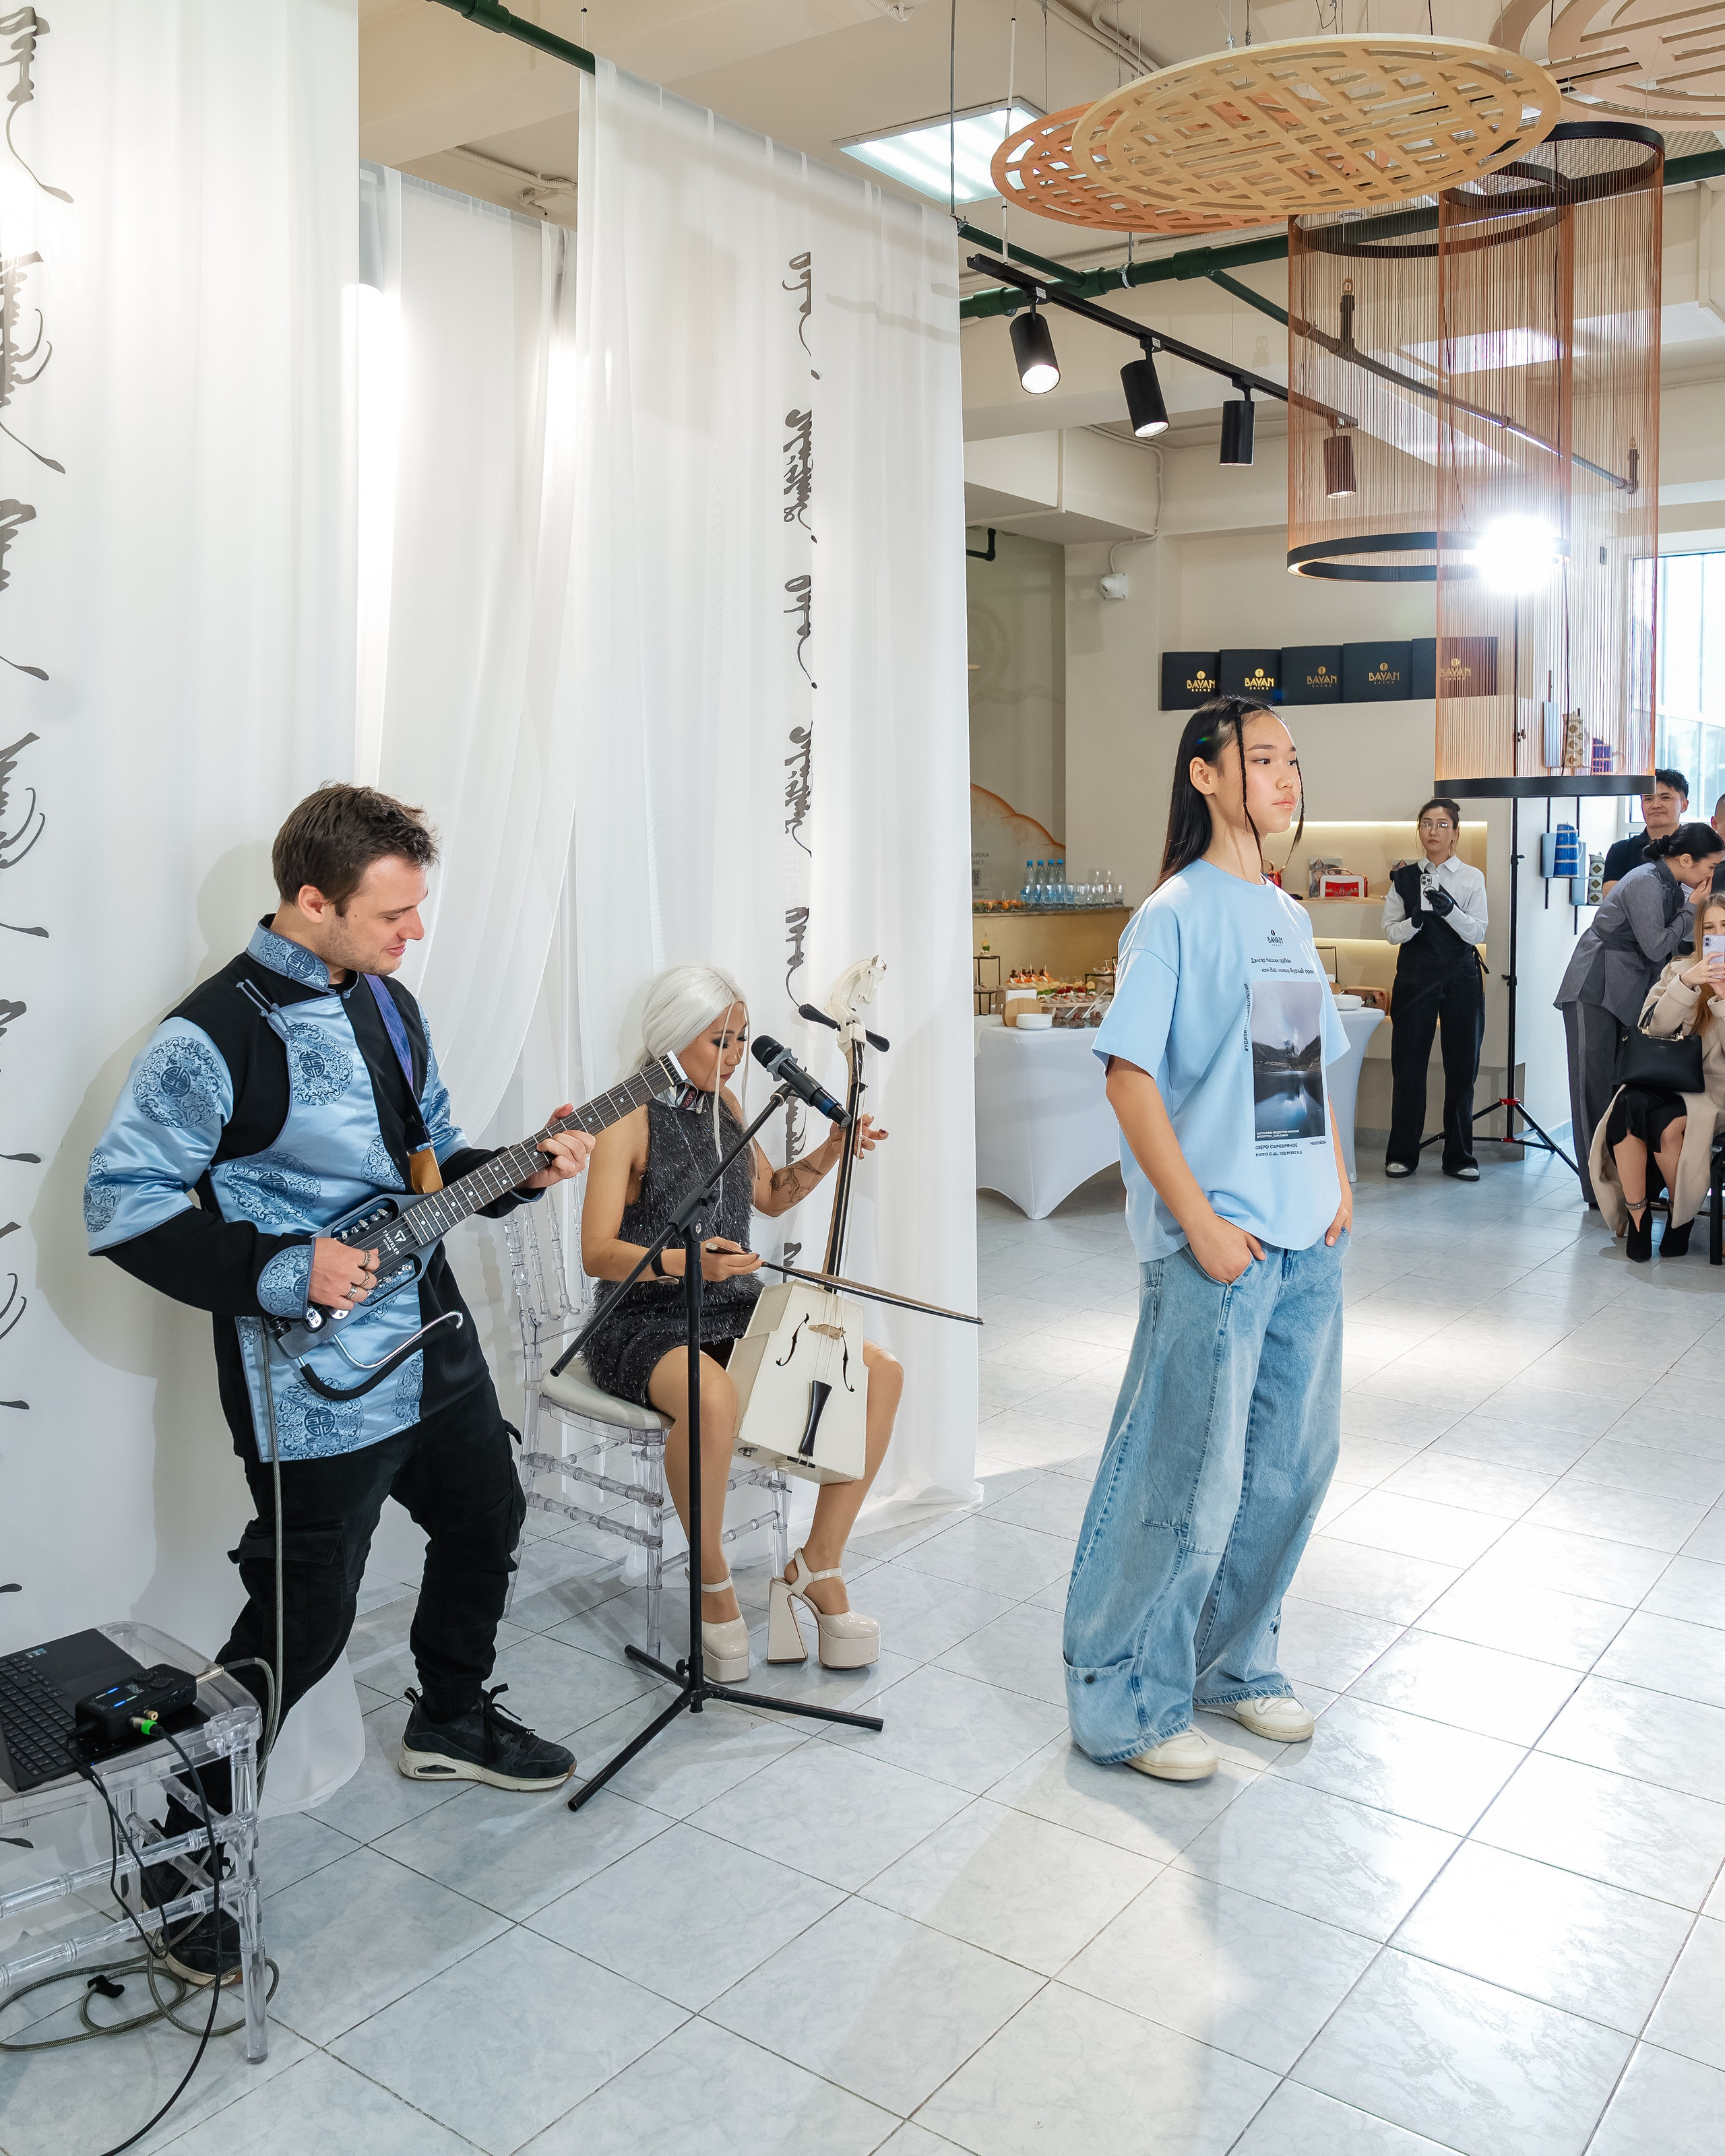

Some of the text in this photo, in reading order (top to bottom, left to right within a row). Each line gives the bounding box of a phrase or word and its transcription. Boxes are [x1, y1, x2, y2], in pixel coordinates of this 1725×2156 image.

[1245, 677, 1274, 687] BAYAN
[1307, 675, 1337, 685] BAYAN
[1369, 672, 1400, 682] BAYAN
[1187, 679, 1216, 689] BAYAN
[383, 1230, 400, 1255] TRAVELER
